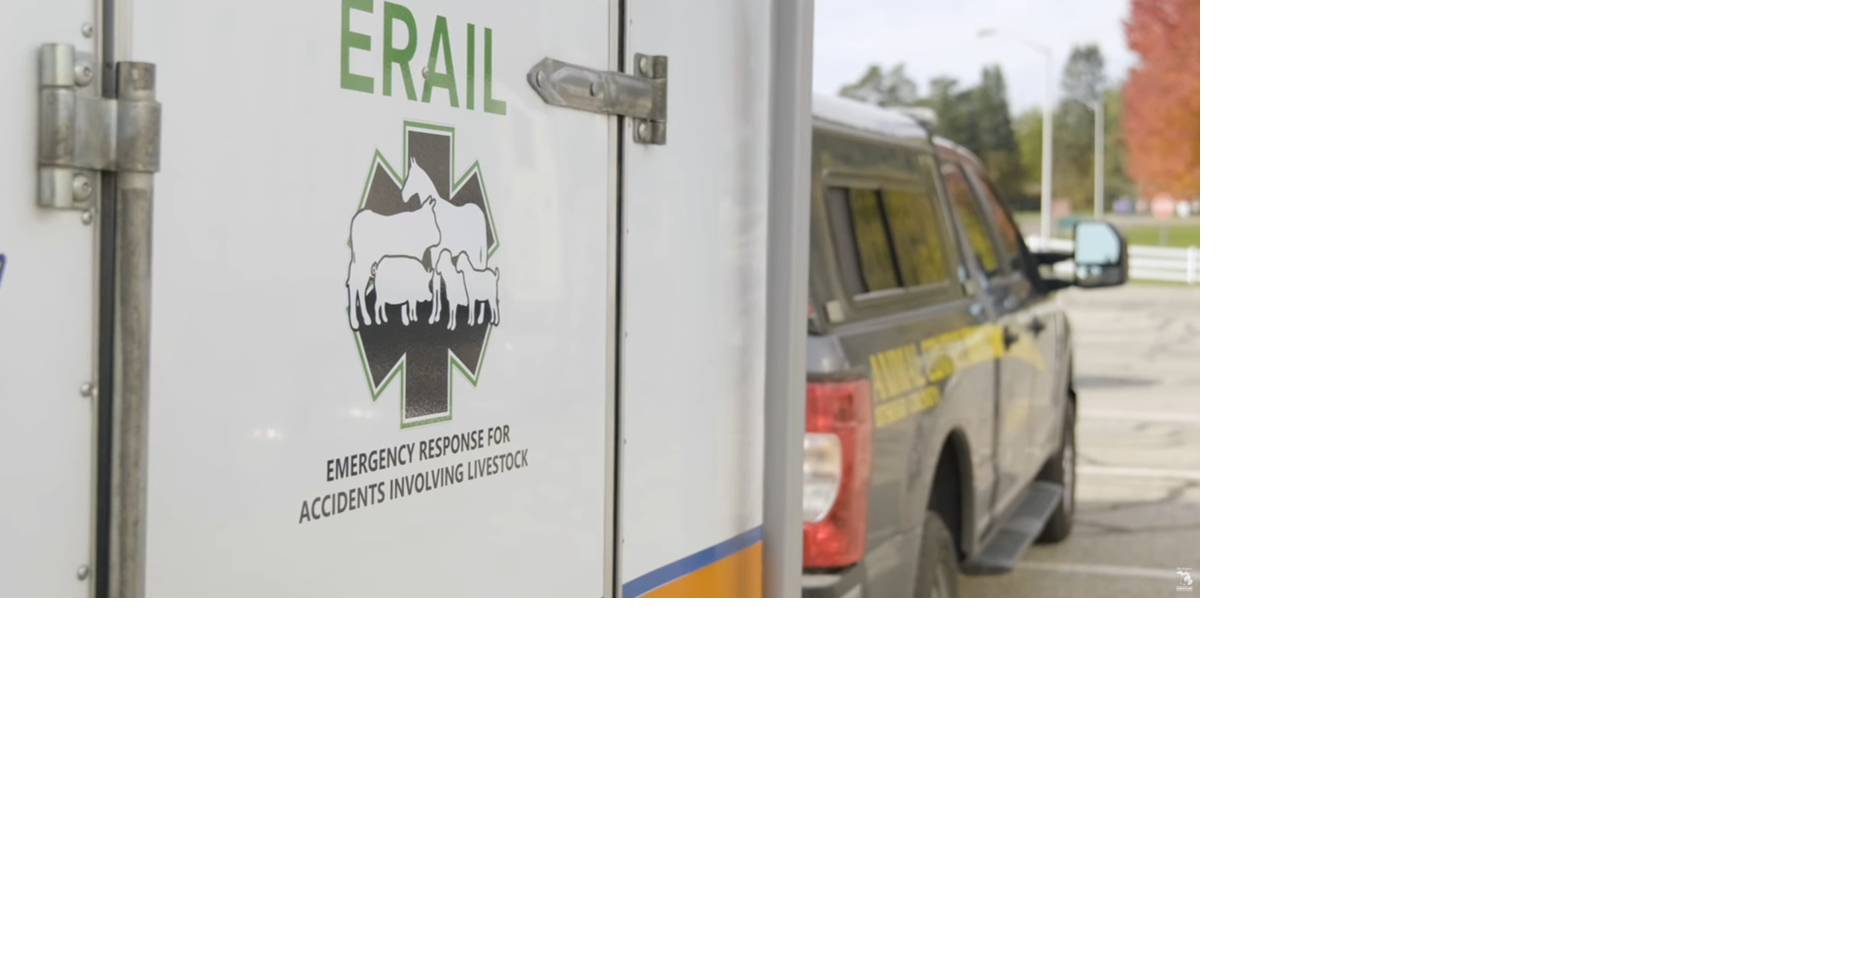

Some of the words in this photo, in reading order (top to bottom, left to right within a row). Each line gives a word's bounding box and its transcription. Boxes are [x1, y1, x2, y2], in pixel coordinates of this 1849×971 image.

[340, 0, 507, 116] ERAIL
[299, 481, 386, 524] ACCIDENTS
[389, 463, 464, 500] INVOLVING
[467, 448, 529, 481] LIVESTOCK
[326, 442, 415, 482] EMERGENCY
[419, 429, 484, 461] RESPONSE
[487, 424, 511, 447] FOR
